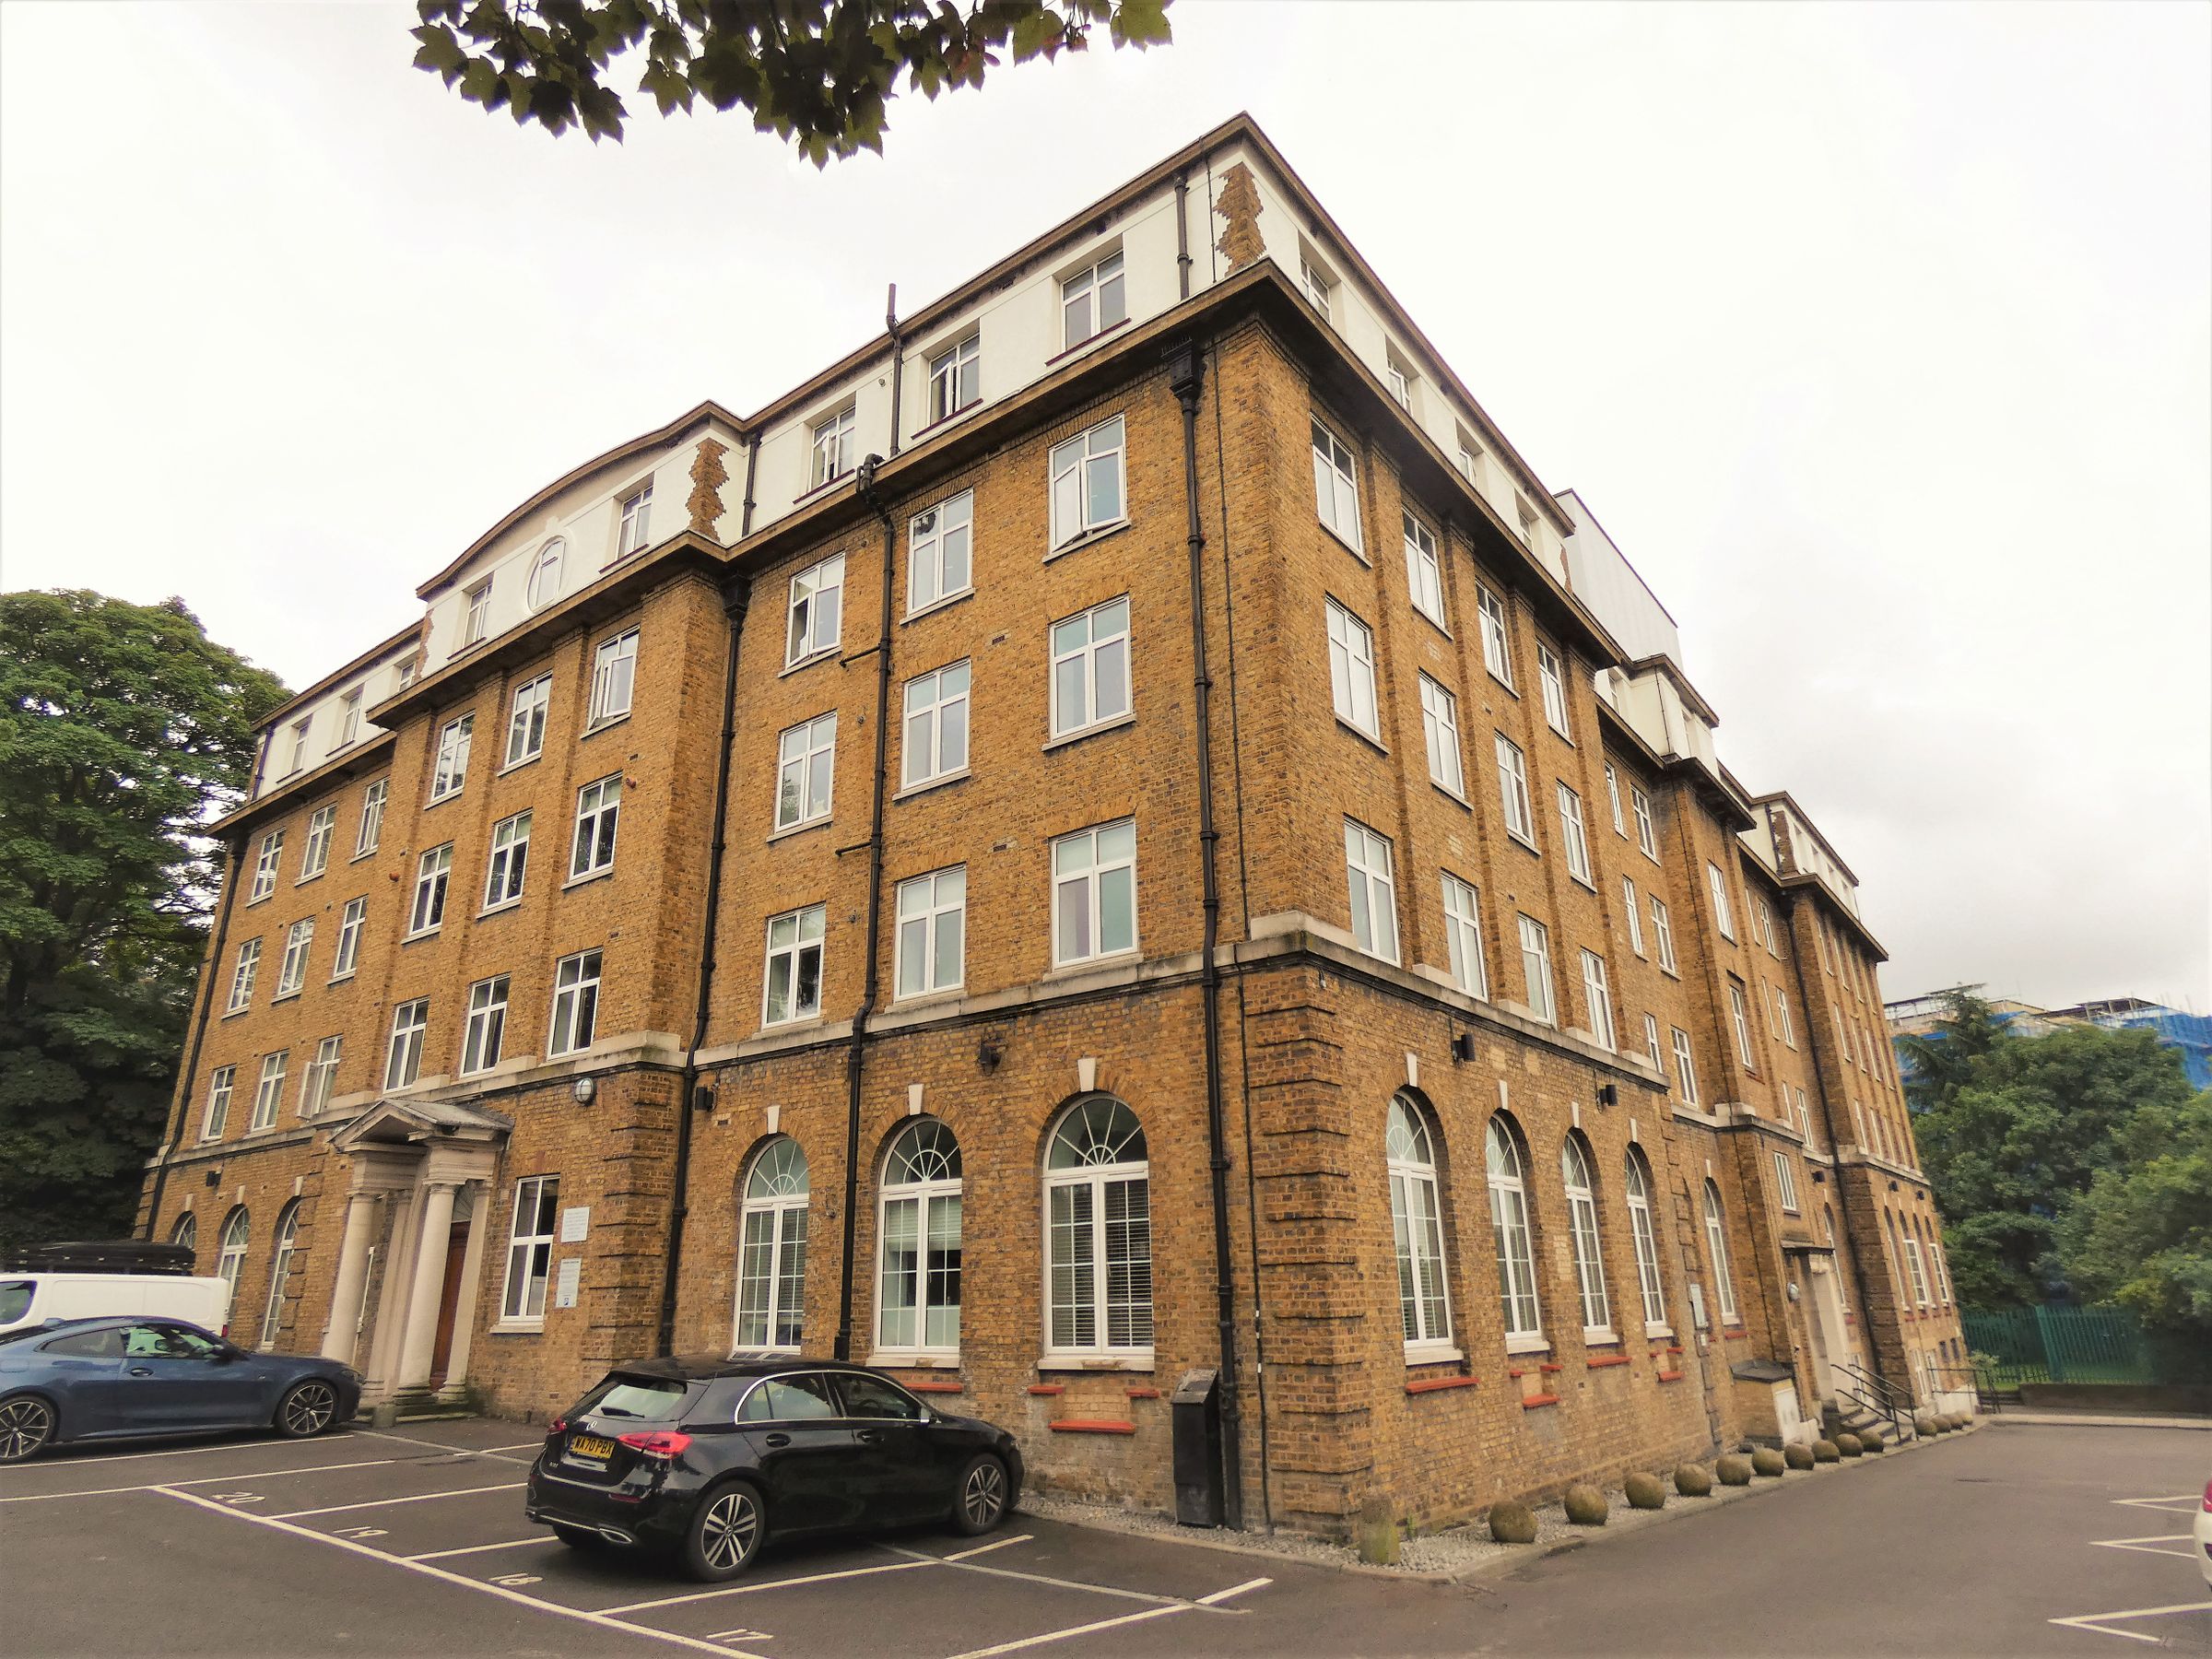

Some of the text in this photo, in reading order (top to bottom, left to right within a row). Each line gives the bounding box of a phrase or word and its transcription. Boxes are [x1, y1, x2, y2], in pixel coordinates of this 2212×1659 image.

[594, 1440, 614, 1455] PBX
[211, 1491, 265, 1503] 20
[332, 1525, 390, 1538] 19
[489, 1572, 544, 1585] 18
[706, 1629, 774, 1642] 17
